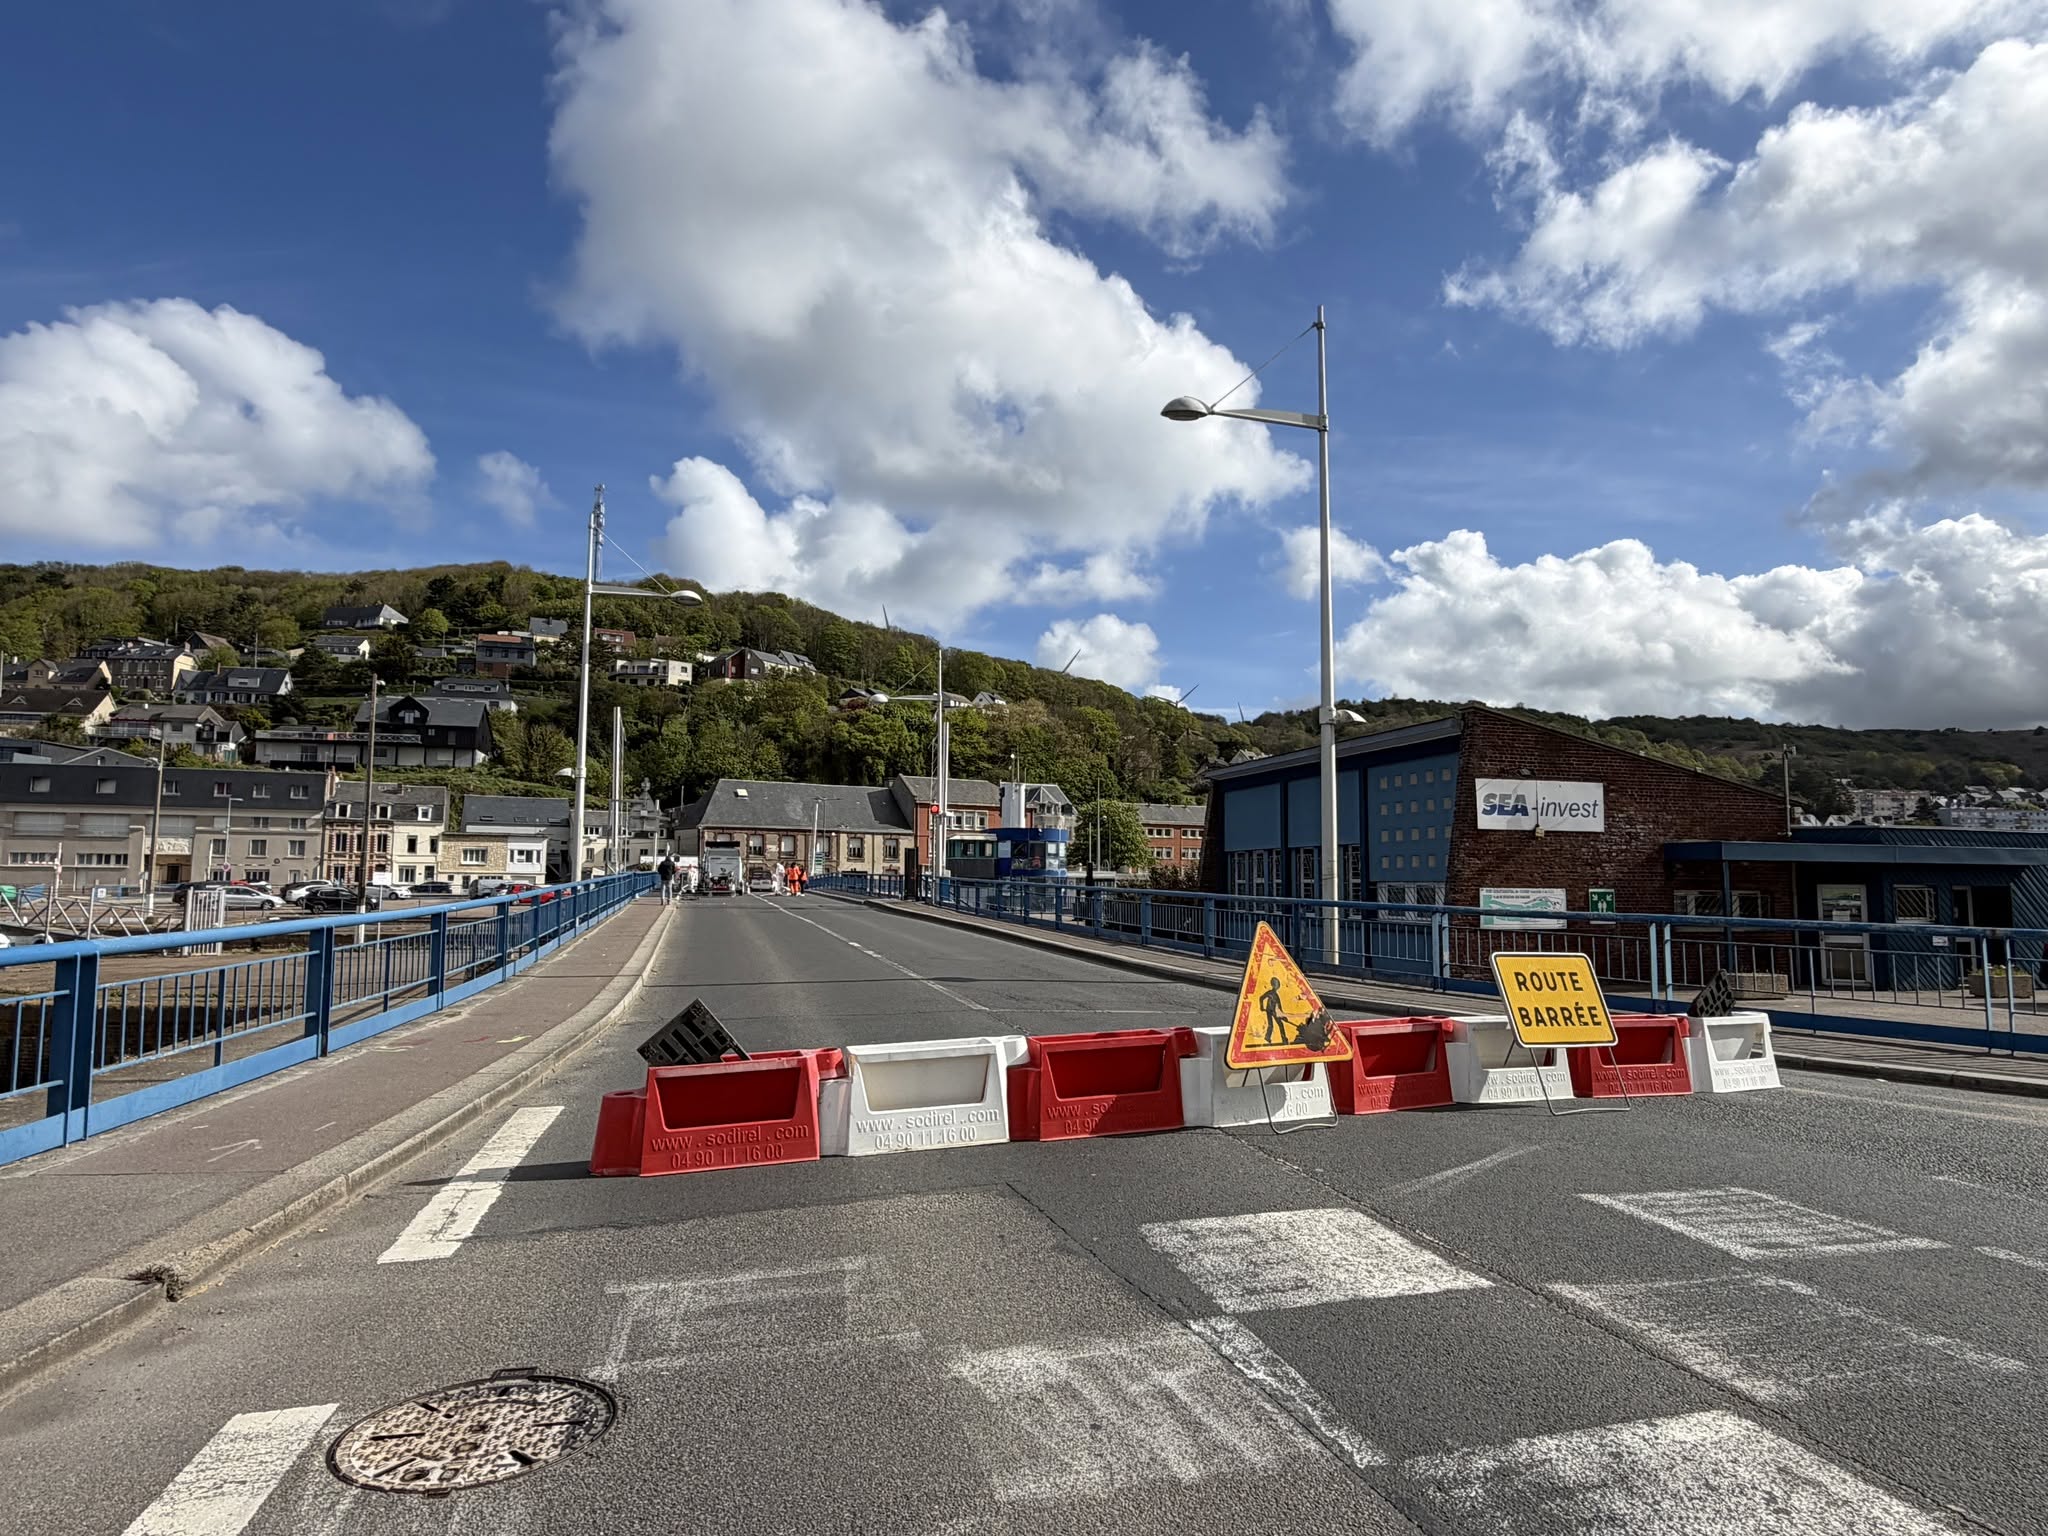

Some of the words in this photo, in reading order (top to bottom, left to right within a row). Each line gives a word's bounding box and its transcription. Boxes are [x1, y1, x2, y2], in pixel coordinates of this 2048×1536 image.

[1513, 971, 1584, 992] ROUTE
[1517, 1001, 1602, 1027] BARRÉE
[1487, 1087, 1499, 1099] 04
[1501, 1086, 1513, 1099] 90
[1637, 1081, 1647, 1093] 11
[1650, 1080, 1660, 1093] 16
[1662, 1080, 1674, 1092] 00
[1065, 1119, 1080, 1135] 04
[874, 1133, 892, 1150] 04
[896, 1131, 914, 1147] 90
[918, 1130, 934, 1146] 11
[941, 1128, 956, 1144] 16
[960, 1126, 976, 1142] 00
[671, 1152, 691, 1169] 04
[695, 1150, 714, 1167] 90
[722, 1147, 736, 1164] 11
[745, 1144, 761, 1162] 16
[764, 1143, 784, 1160] 00
